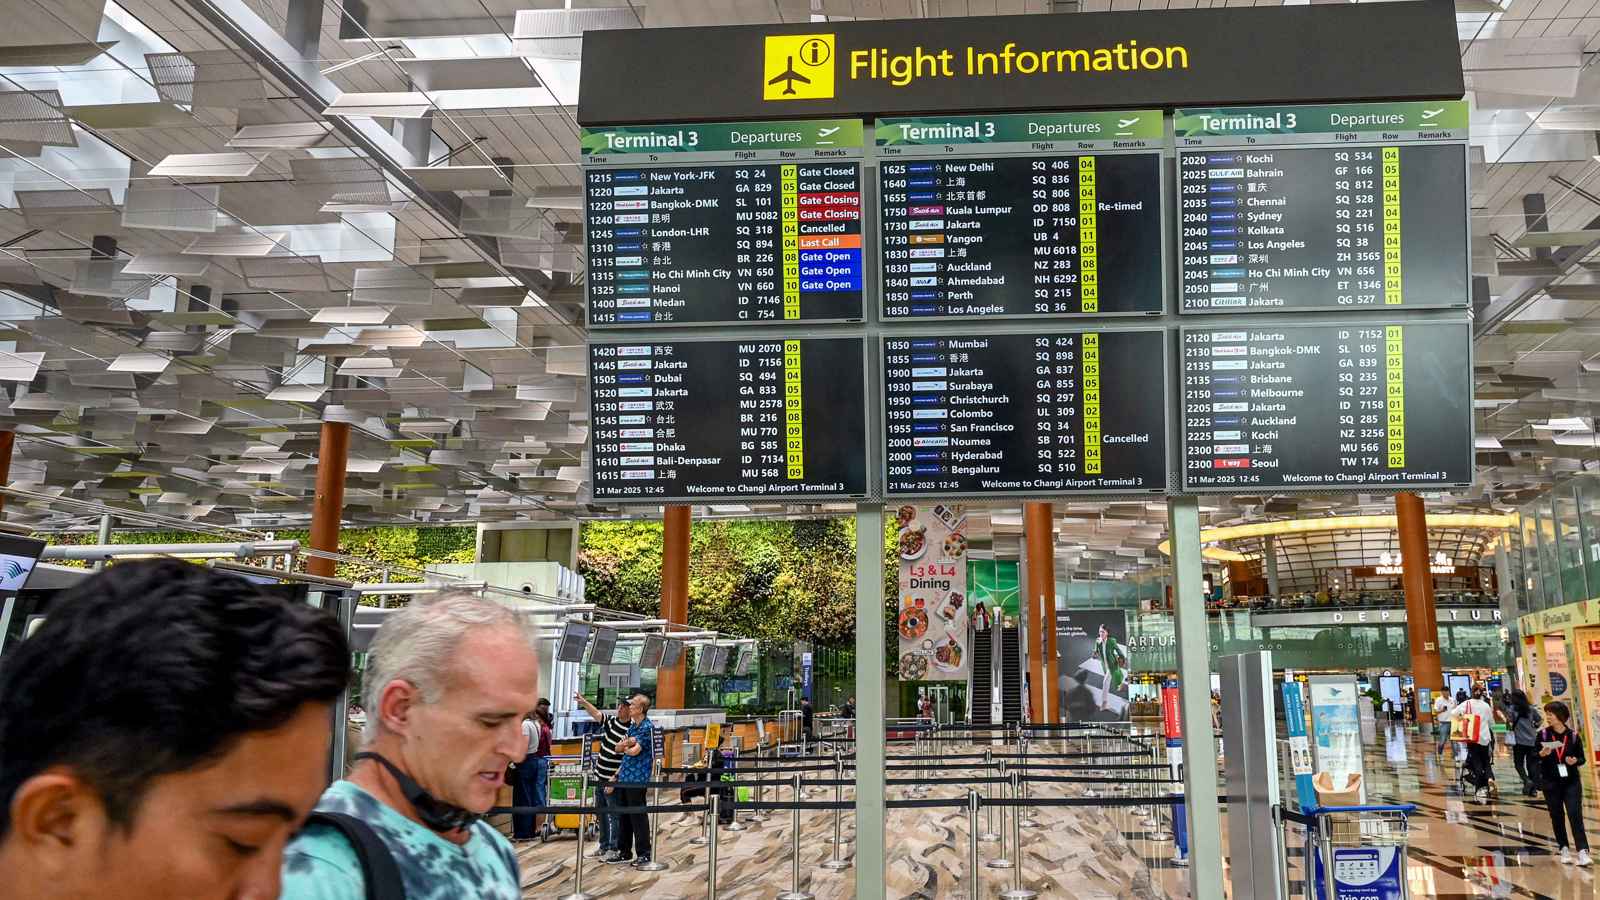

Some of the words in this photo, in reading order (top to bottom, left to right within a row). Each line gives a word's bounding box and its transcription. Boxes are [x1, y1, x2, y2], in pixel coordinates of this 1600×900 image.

[851, 47, 954, 86] Flight
[968, 40, 1188, 75] Information
[1199, 113, 1281, 131] Terminal
[1286, 113, 1296, 128] 3
[1331, 114, 1404, 128] Departures
[898, 122, 979, 140] Terminal
[985, 122, 995, 137] 3
[1028, 122, 1101, 136] Departures
[1336, 133, 1357, 141] Flight
[604, 131, 683, 148] Terminal
[688, 131, 698, 146] 3
[731, 131, 802, 146] Departures
[1032, 142, 1054, 150] Flight
[1113, 140, 1146, 148] Remarks
[735, 151, 756, 159] Flight
[884, 165, 906, 174] 1625
[946, 164, 967, 172] New
[970, 162, 994, 172] Delhi
[1032, 161, 1046, 170] SQ
[1052, 160, 1069, 169] 406
[1183, 170, 1206, 179] 2025
[1247, 168, 1283, 178] Bahrain
[1335, 167, 1348, 175] GF
[1356, 166, 1373, 175] 166
[1385, 166, 1396, 174] 05
[590, 174, 612, 182] 1215
[673, 171, 715, 180] York-JFK
[736, 170, 749, 179] SQ
[754, 169, 766, 178] 24
[799, 168, 821, 176] Gate
[823, 166, 854, 176] Closed
[884, 194, 906, 202] 1655
[1033, 190, 1046, 199] SQ
[1052, 189, 1070, 198] 806
[1081, 188, 1093, 197] 04
[884, 208, 907, 216] 1750
[946, 206, 972, 215] Kuala
[975, 206, 1012, 216] Lumpur
[1033, 204, 1048, 212] OD
[1052, 204, 1070, 212] 808
[1082, 203, 1092, 211] 01
[1098, 201, 1142, 211] Re-timed
[1184, 213, 1207, 222] 2040
[1247, 211, 1282, 222] Sydney
[1336, 210, 1350, 219] SQ
[1356, 209, 1372, 218] 221
[1386, 208, 1397, 216] 04
[591, 244, 613, 252] 1310
[737, 240, 750, 249] SQ
[756, 240, 773, 248] 894
[801, 238, 820, 248] Last
[822, 237, 840, 247] Call
[592, 272, 614, 280] 1315
[652, 271, 666, 279] Ho
[668, 270, 684, 279] Chi
[686, 269, 710, 278] Minh
[713, 269, 731, 279] City
[738, 268, 752, 277] VN
[756, 268, 774, 276] 650
[786, 267, 797, 276] 10
[802, 267, 823, 275] Gate
[826, 266, 851, 277] Open
[888, 397, 910, 405] 1950
[950, 395, 1009, 404] Christchurch
[1037, 394, 1050, 403] SQ
[1057, 393, 1074, 402] 297
[1085, 393, 1097, 401] 04
[888, 438, 912, 447] 2000
[1038, 436, 1050, 444] SB
[1058, 435, 1074, 444] 701
[1103, 434, 1148, 443] Cancelled
[596, 458, 618, 466] 1610
[657, 456, 721, 467] Bali-Denpasar
[742, 456, 752, 464] ID
[761, 455, 784, 463] 7134
[789, 455, 800, 463] 01
[1188, 460, 1212, 469] 2300
[1252, 458, 1278, 468] Seoul
[1340, 457, 1357, 466] TW
[1362, 457, 1379, 466] 174
[1390, 457, 1402, 465] 02
[1034, 479, 1063, 488] Changi
[1065, 478, 1096, 488] Airport
[1098, 477, 1135, 486] Terminal
[1336, 473, 1366, 483] Changi
[1368, 473, 1399, 482] Airport
[1401, 472, 1439, 480] Terminal
[738, 484, 766, 494] Changi
[768, 484, 798, 493] Airport
[800, 483, 837, 491] Terminal
[910, 565, 924, 577] L3
[928, 565, 937, 576] &
[941, 564, 956, 576] L4
[910, 578, 950, 591] Dining
